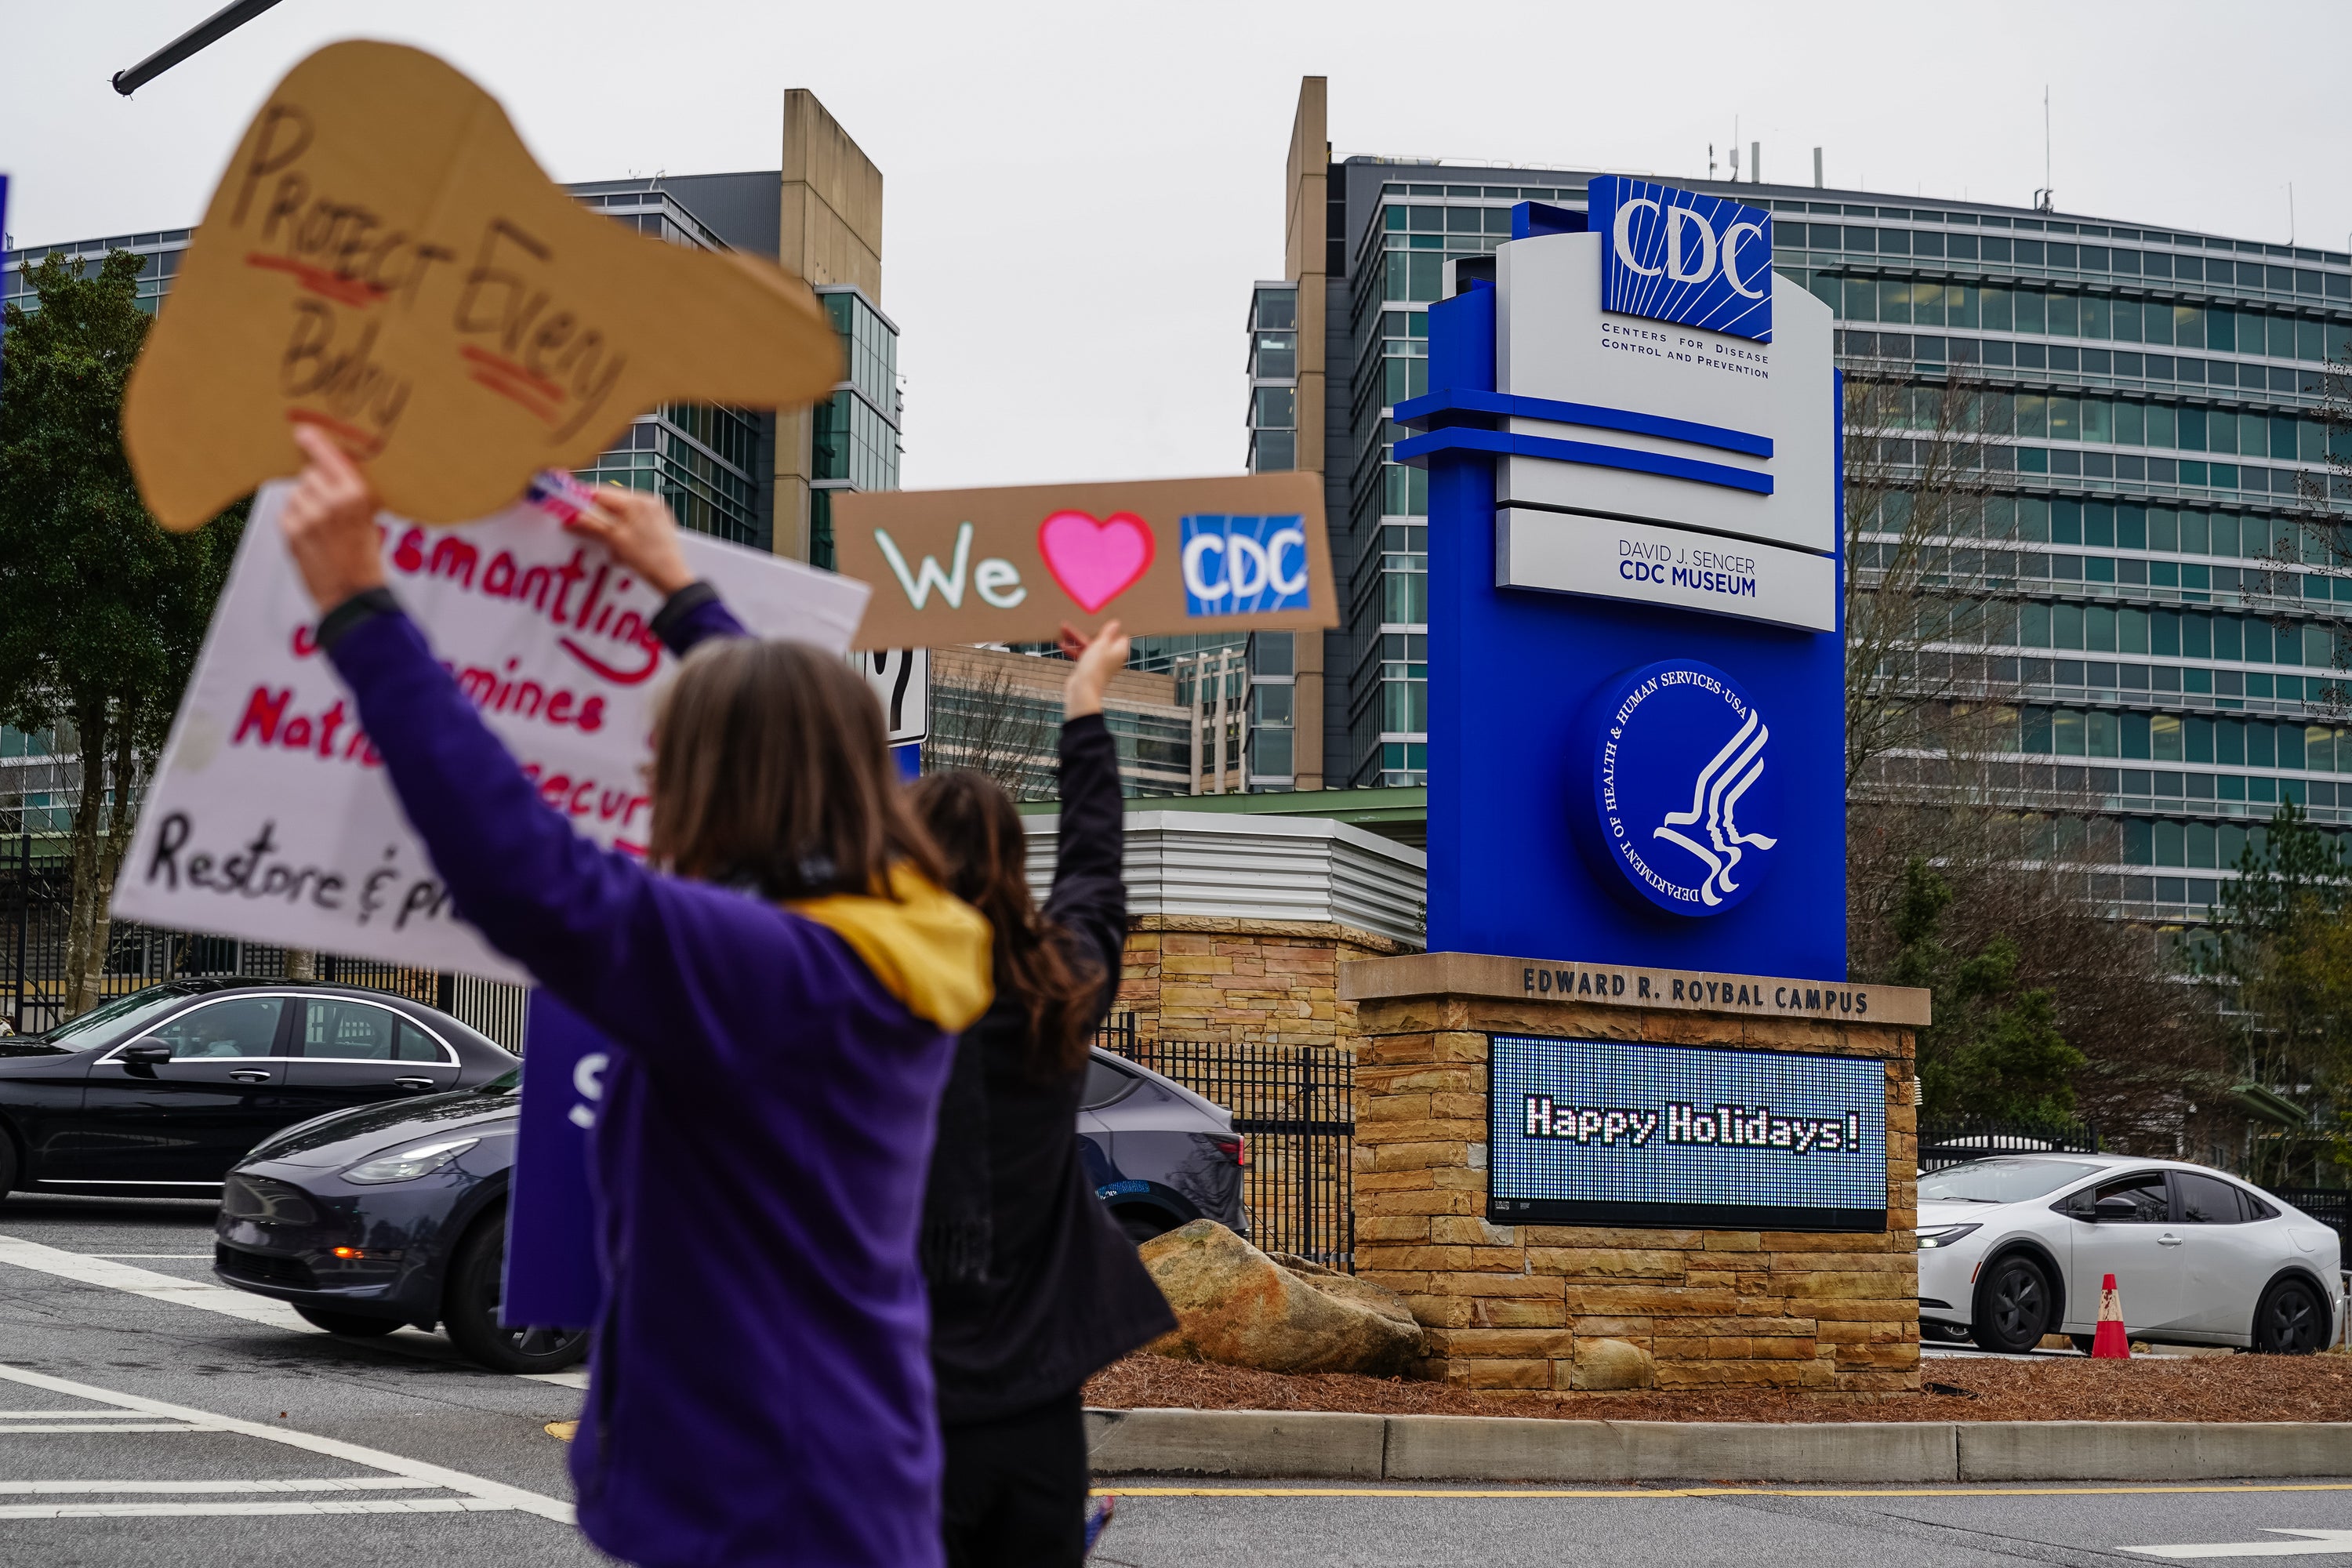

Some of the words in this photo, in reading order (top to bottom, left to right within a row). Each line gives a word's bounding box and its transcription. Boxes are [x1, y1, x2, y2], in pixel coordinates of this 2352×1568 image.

[1613, 198, 1765, 299] CDC
[1601, 322, 1668, 343] CENTERS
[1679, 337, 1704, 350] FOR
[1715, 343, 1769, 365] DISEASE
[1601, 338, 1661, 358] CONTROL
[1667, 350, 1692, 363] AND
[1697, 355, 1769, 379] PREVENTION
[874, 521, 1027, 611] We
[1181, 528, 1308, 601] CDC
[1619, 539, 1671, 562] DAVID
[1676, 548, 1688, 565] J.
[1693, 550, 1755, 575] SENCER
[1619, 559, 1665, 584] CDC
[1671, 567, 1756, 598] MUSEUM
[379, 522, 664, 687] smantling
[1615, 677, 1659, 726] HUMAN
[1610, 726, 1622, 740] &
[1602, 741, 1617, 811] HEALTH
[1609, 816, 1624, 838] OF
[147, 811, 346, 909] Restore
[1620, 840, 1700, 902] DEPARTMENT
[1523, 967, 1626, 996] EDWARD
[1638, 976, 1661, 1000] R.
[1673, 978, 1764, 1007] ROYBAL
[1775, 986, 1868, 1014] CAMPUS
[1525, 1095, 1657, 1146] Happy
[1667, 1104, 1860, 1152] Holidays!
